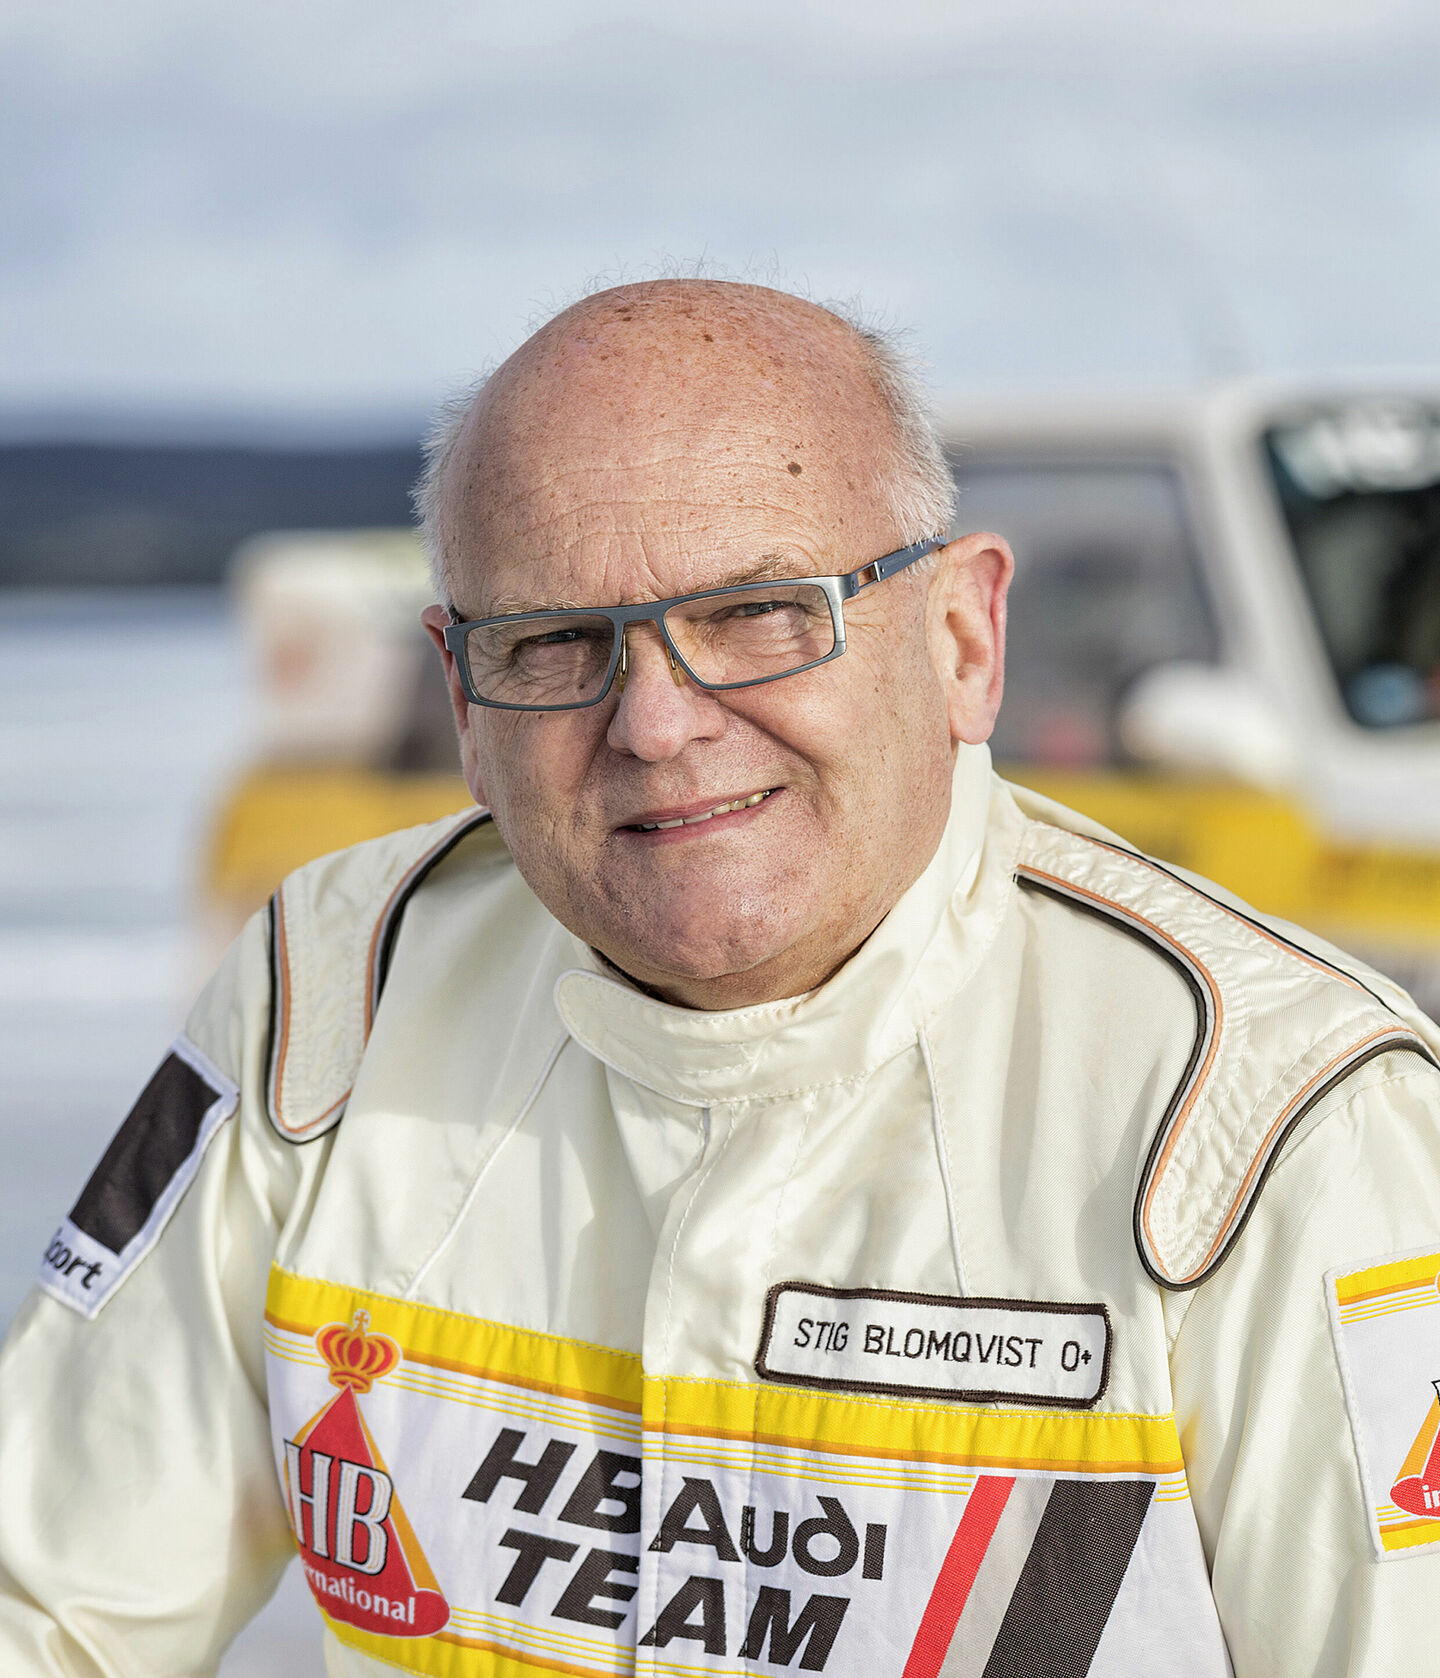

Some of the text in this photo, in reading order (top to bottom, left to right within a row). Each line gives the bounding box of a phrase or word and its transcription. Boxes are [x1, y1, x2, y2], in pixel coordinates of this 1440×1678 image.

[794, 1318, 849, 1351] STIG
[862, 1324, 1043, 1368] BLOMQVIST
[283, 1438, 393, 1576] HB
[461, 1427, 642, 1535] HB
[494, 1528, 851, 1672] TEAM
